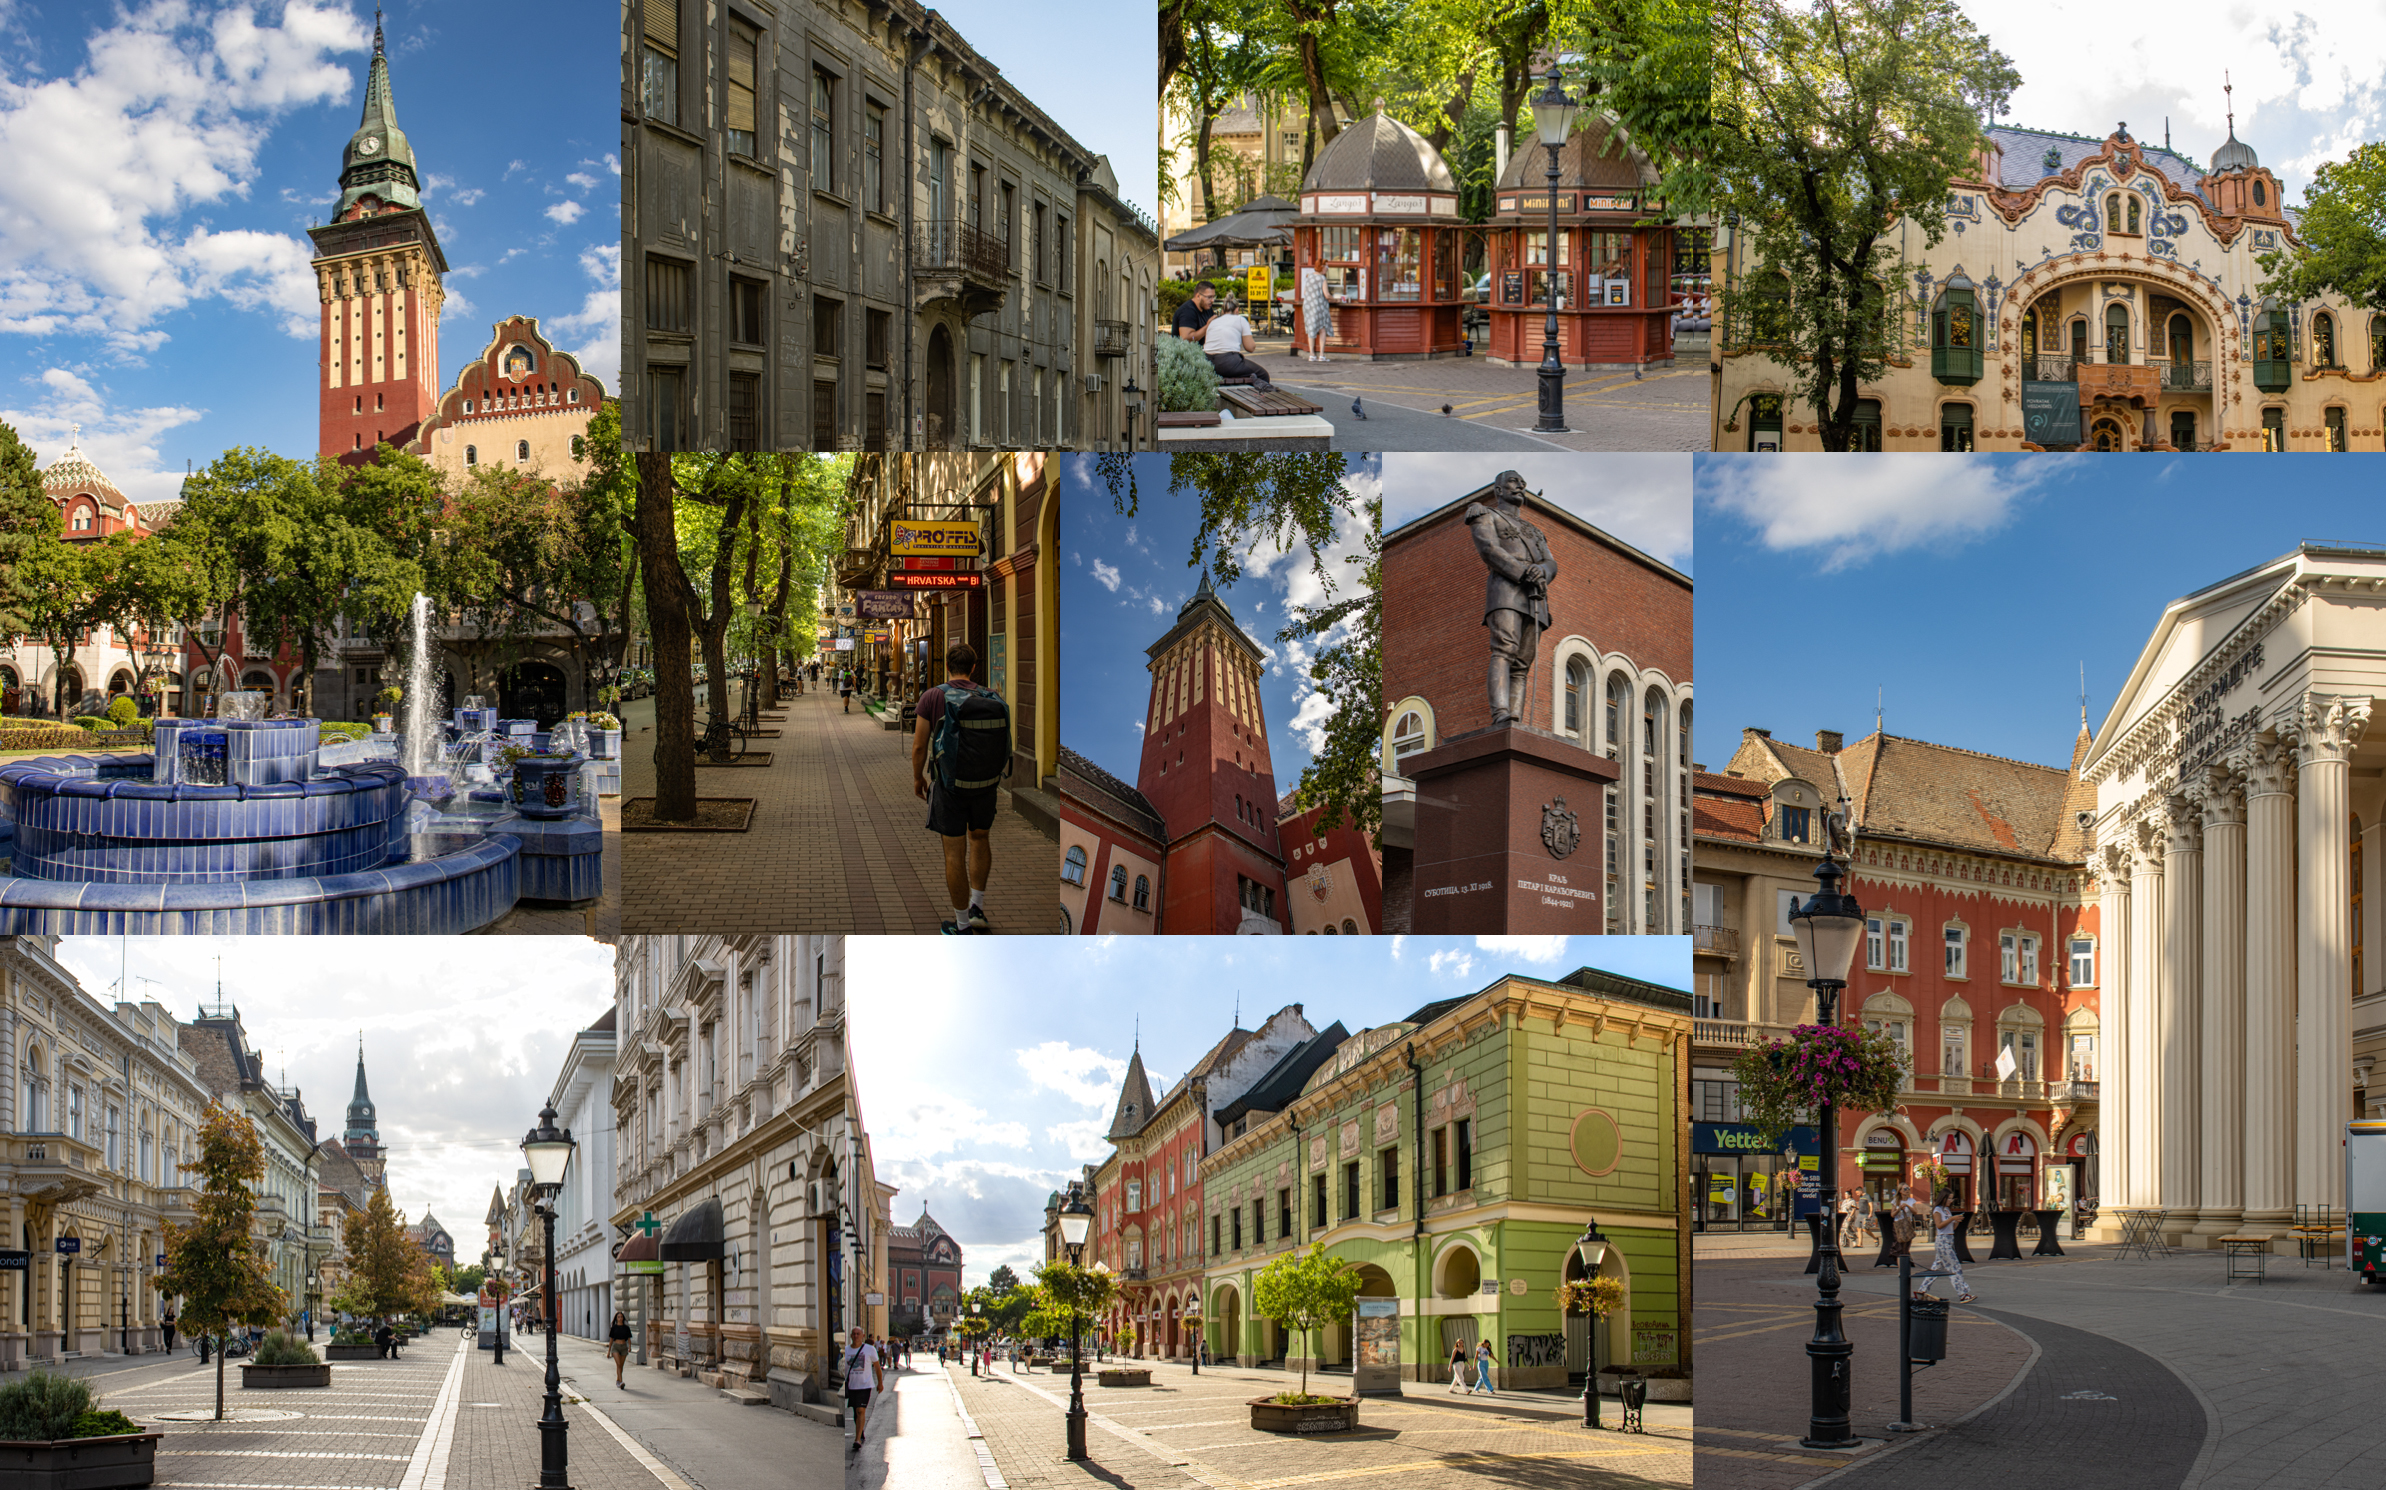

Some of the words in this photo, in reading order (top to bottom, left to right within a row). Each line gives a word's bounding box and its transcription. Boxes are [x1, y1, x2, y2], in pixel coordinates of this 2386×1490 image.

[907, 576, 956, 585] HRVATSKA
[2176, 643, 2264, 732] ПОЗОРИШТЕ
[1548, 874, 1568, 884] КРАЉ
[1478, 880, 1494, 892] 1918.
[1518, 880, 1540, 891] ПЕТАР
[1868, 1136, 1888, 1144] BENU
[1943, 1131, 1960, 1152] A1
[2008, 1133, 2023, 1154] A1
